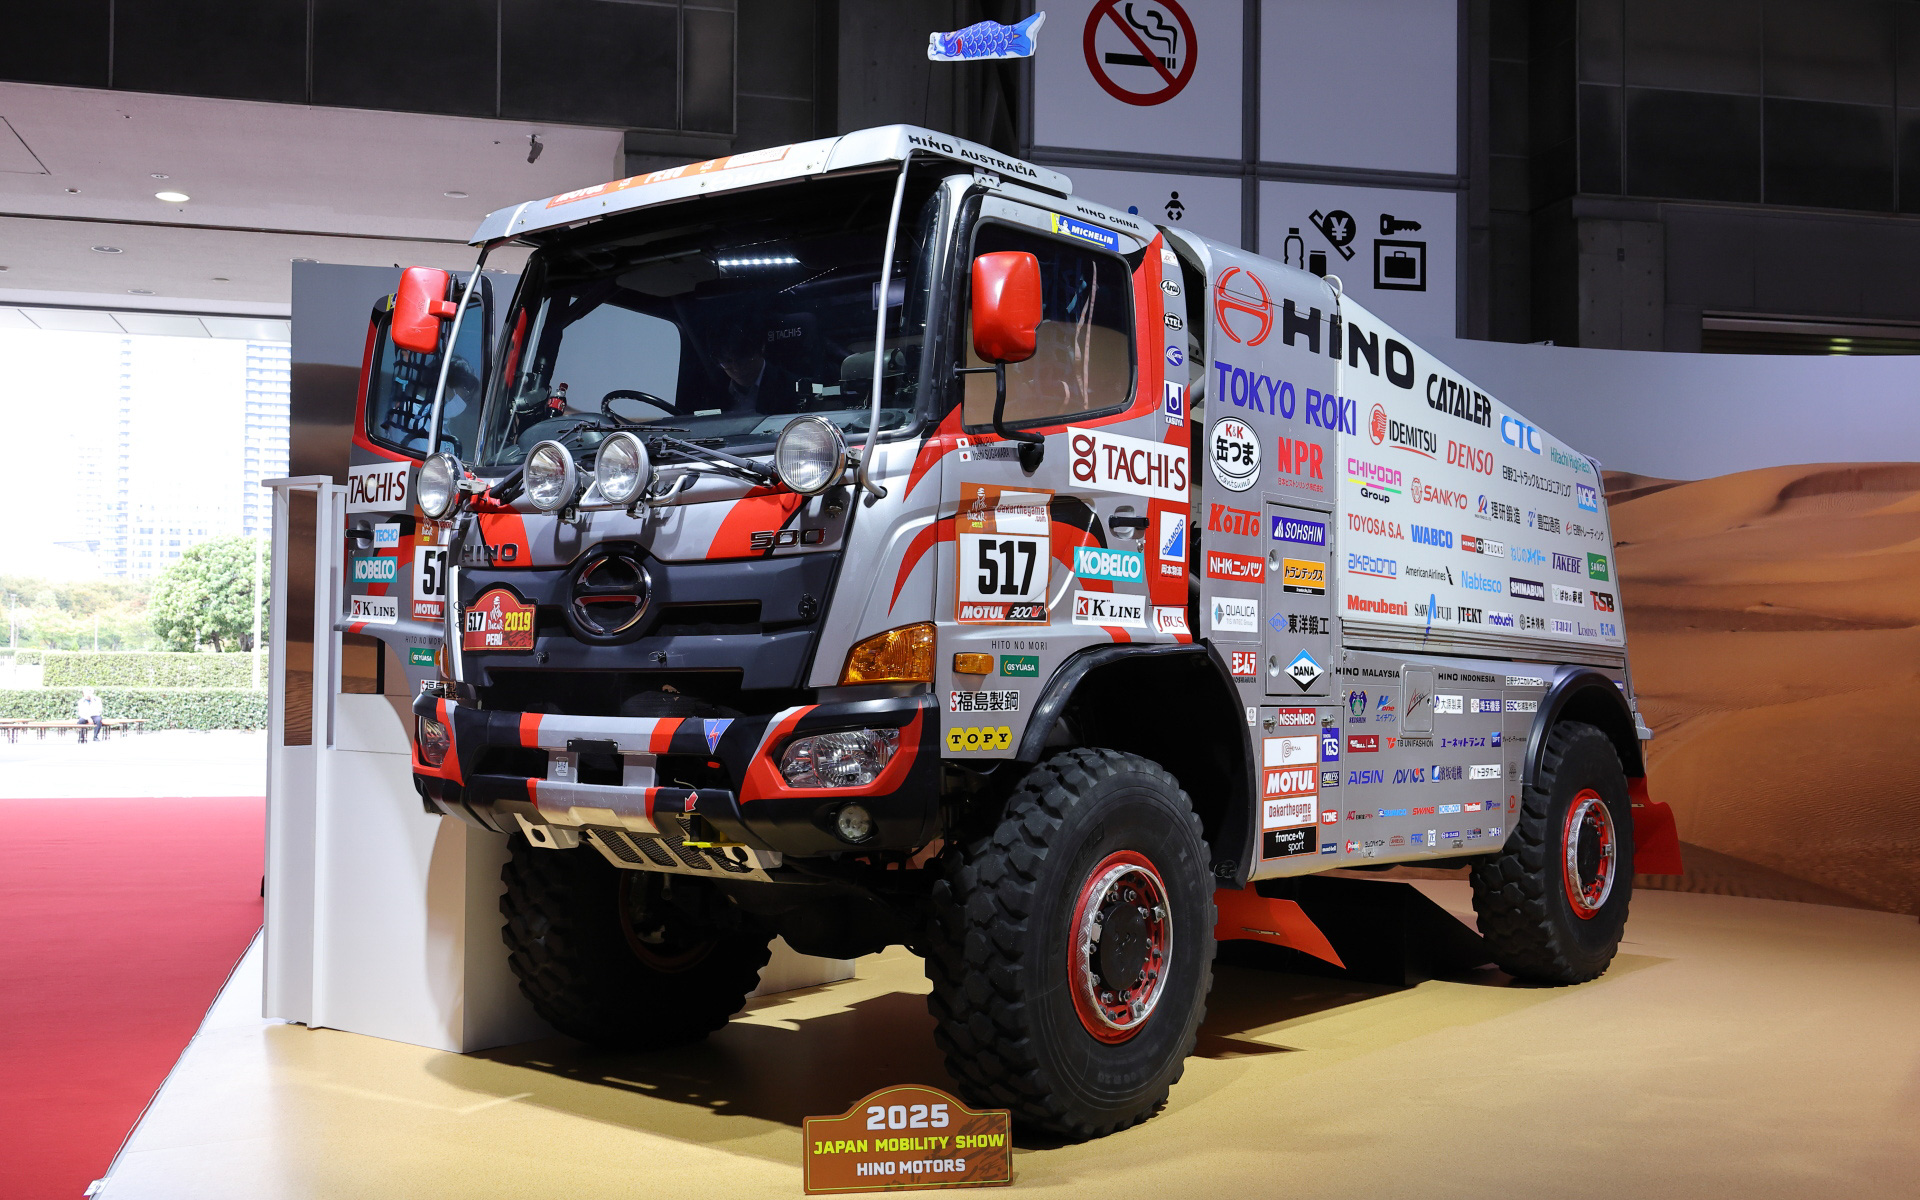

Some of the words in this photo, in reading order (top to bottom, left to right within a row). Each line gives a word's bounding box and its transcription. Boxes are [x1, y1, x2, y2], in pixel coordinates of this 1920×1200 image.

[908, 135, 954, 154] HINO
[961, 149, 1038, 178] AUSTRALIA
[1076, 205, 1106, 220] HINO
[1109, 215, 1140, 230] CHINA
[1071, 225, 1114, 245] MICHELIN
[1164, 283, 1180, 294] Arai
[1165, 317, 1182, 328] KTEL
[775, 327, 802, 340] TACHI-S
[1283, 298, 1415, 390] HINO
[1215, 361, 1296, 420] TOKYO
[1306, 388, 1357, 436] ROKI
[1427, 373, 1492, 428] CATALER
[1165, 416, 1183, 427] KASUYA
[1225, 423, 1244, 439] K&K
[1389, 419, 1437, 453] IDEMITSU
[1501, 415, 1541, 455] CTC
[1216, 435, 1254, 466] 缶つま
[1278, 436, 1324, 480] NPR
[1447, 440, 1494, 476] DENSO
[1102, 443, 1187, 491] TACHI-S
[1347, 457, 1402, 486] CHIYODA
[349, 471, 406, 504] TACHI-S
[1360, 487, 1390, 504] Group
[1423, 485, 1468, 510] SANKYO
[1577, 486, 1597, 509] NOK
[997, 504, 1045, 517] Dakarthegame
[1491, 501, 1521, 525] 理研鍛造
[1284, 521, 1324, 543] SOHSHIN
[1347, 513, 1386, 537] TOYOSA
[1388, 522, 1405, 541] S.A.
[1411, 524, 1453, 549] WABCO
[750, 527, 827, 550] 500
[1161, 518, 1184, 557] OKAMOTO
[1462, 540, 1475, 548] HINO
[461, 543, 519, 562] HINO
[1484, 542, 1504, 555] TRUCKS
[355, 560, 395, 580] KOBELCO
[423, 550, 448, 596] 51
[978, 539, 1037, 596] 517
[1079, 550, 1141, 579] KOBELCO
[1209, 556, 1263, 578] NHKニッパツ
[1348, 553, 1397, 576] akebono
[1552, 552, 1583, 575] TAKEBE
[1590, 562, 1606, 573] SANGO
[1284, 565, 1324, 582] トランテックス
[1405, 566, 1429, 578] American
[1428, 569, 1447, 581] Airlines
[1461, 570, 1503, 593] Nabtesco
[1510, 581, 1543, 598] SHIMABUN
[373, 606, 396, 617] LINE
[415, 603, 440, 615] MOTUL
[960, 605, 1005, 620] MOTUL
[1010, 605, 1042, 618] 300V
[1110, 605, 1141, 619] LINE
[1225, 603, 1256, 618] QUALICA
[1347, 594, 1408, 616] Marubeni
[467, 611, 484, 632] 517
[504, 611, 531, 632] 2019
[1287, 613, 1330, 636] 東洋鍛工
[1457, 606, 1482, 625] JTEKT
[419, 636, 427, 644] NO
[486, 632, 503, 646] PERÚ
[991, 640, 1011, 650] HITO
[1014, 641, 1025, 650] NO
[1028, 641, 1048, 651] MORI
[1006, 663, 1015, 671] GS
[1015, 663, 1036, 672] YUASA
[1232, 652, 1256, 675] ヨシムラ
[1293, 666, 1315, 677] DANA
[1335, 667, 1359, 676] HINO
[1362, 668, 1400, 678] MALAYSIA
[1438, 673, 1459, 681] HINO
[1460, 674, 1496, 683] INDONESIA
[957, 691, 1019, 712] 福島製鋼
[1506, 701, 1517, 711] SSC
[1279, 708, 1315, 726] NISSHINBO
[1375, 713, 1396, 723] エイチワン
[951, 733, 1009, 745] TOPY
[1397, 739, 1405, 748] TB
[1405, 739, 1434, 748] UNIFASHION
[1440, 737, 1486, 748] ユーネットランス
[1348, 769, 1384, 785] AISIN
[1392, 768, 1425, 784] ADVICS
[1477, 766, 1501, 777] トヨタホーム
[1266, 769, 1315, 795] MOTUL
[1268, 803, 1312, 818] Dakarthegame
[1300, 813, 1312, 823] .com
[1322, 811, 1337, 823] TONE
[1288, 841, 1305, 855] sport
[866, 1103, 950, 1131] 2025
[813, 1139, 868, 1155] JAPAN
[875, 1136, 949, 1152] MOBILITY
[955, 1133, 1005, 1149] SHOW
[856, 1161, 896, 1176] HINO
[899, 1158, 966, 1175] MOTORS
